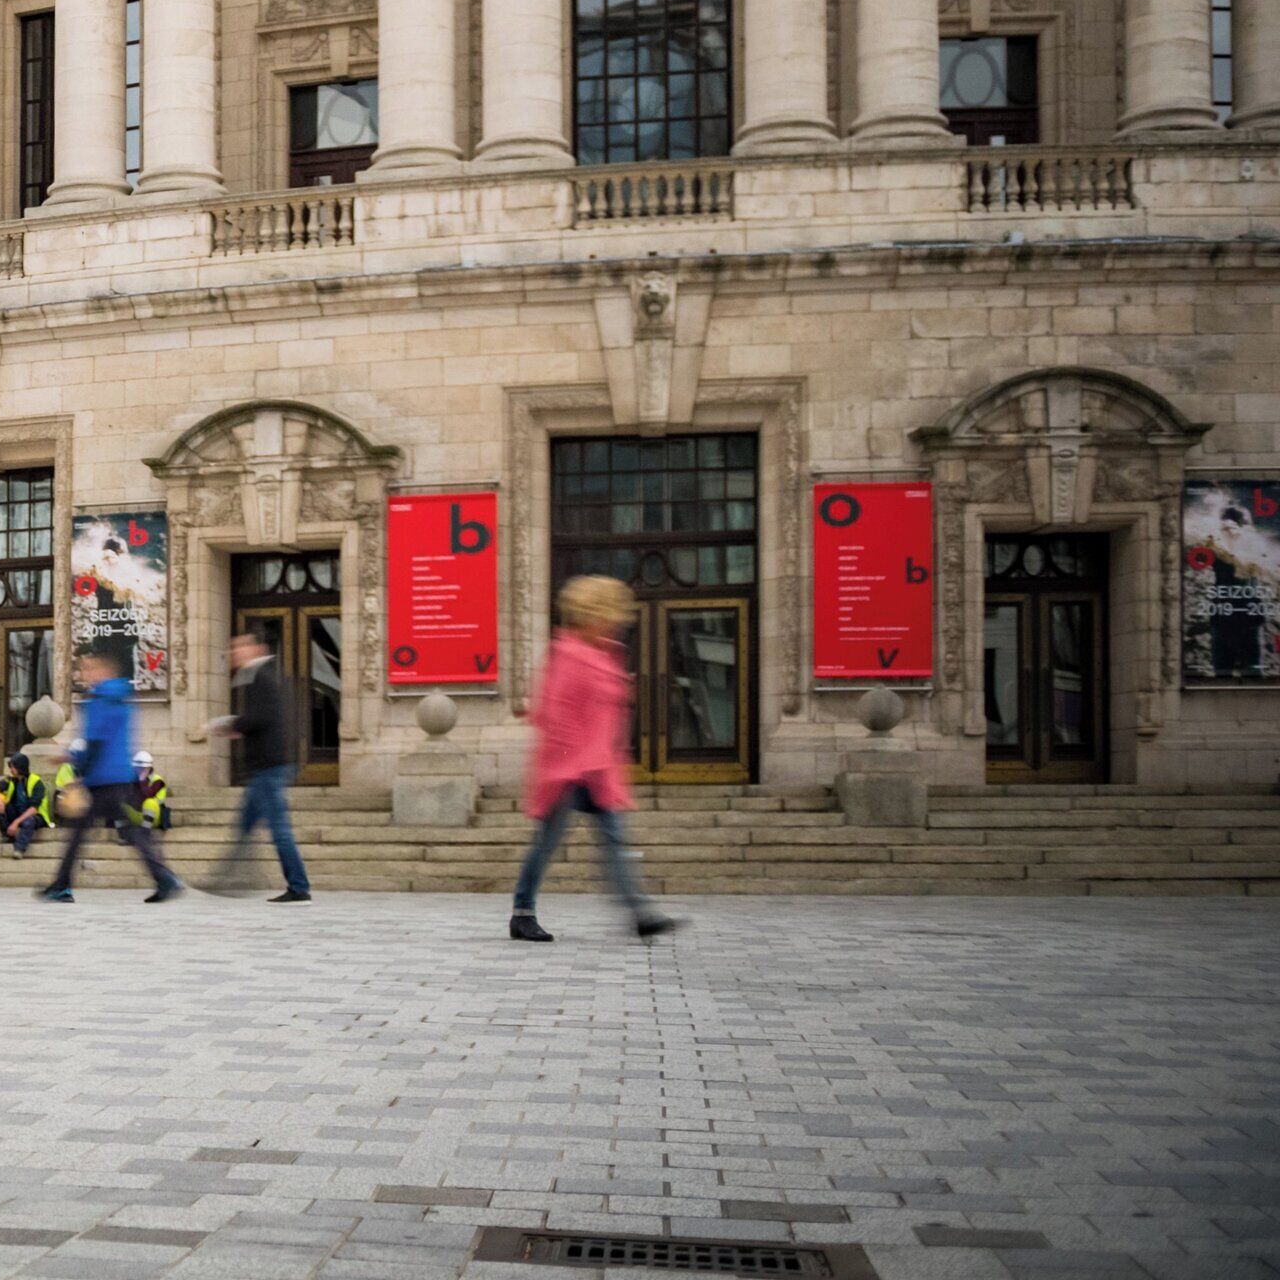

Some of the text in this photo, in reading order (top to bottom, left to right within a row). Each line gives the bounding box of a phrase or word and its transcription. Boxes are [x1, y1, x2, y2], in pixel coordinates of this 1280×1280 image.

[1252, 487, 1279, 518] b
[128, 520, 149, 546] b
[450, 504, 491, 554] b
[905, 556, 928, 585] b
[89, 608, 148, 622] SEIZOEN
